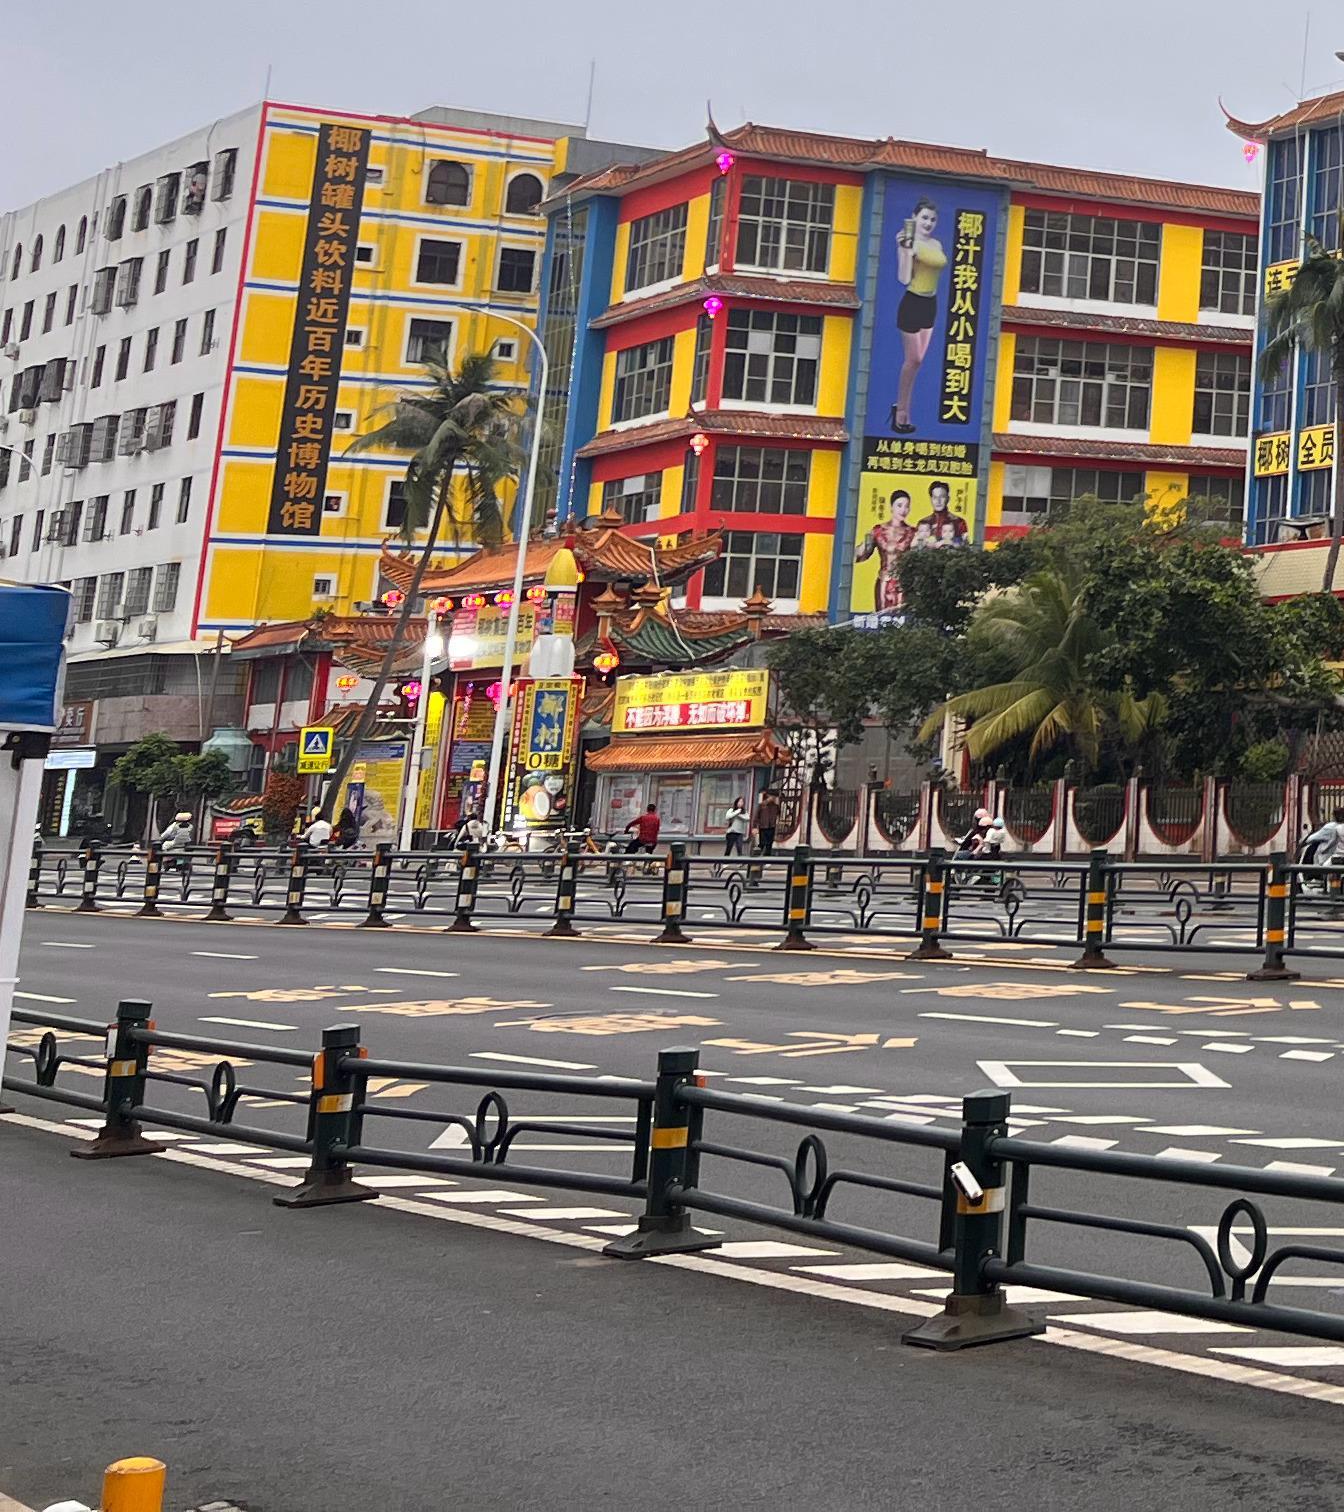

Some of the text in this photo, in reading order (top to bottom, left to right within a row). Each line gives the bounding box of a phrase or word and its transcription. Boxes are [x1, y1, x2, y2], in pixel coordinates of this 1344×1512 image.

[279, 126, 362, 530] 椰树罐头饮料近百年历史博物馆
[942, 211, 984, 422] 椰汁我从小喝到大
